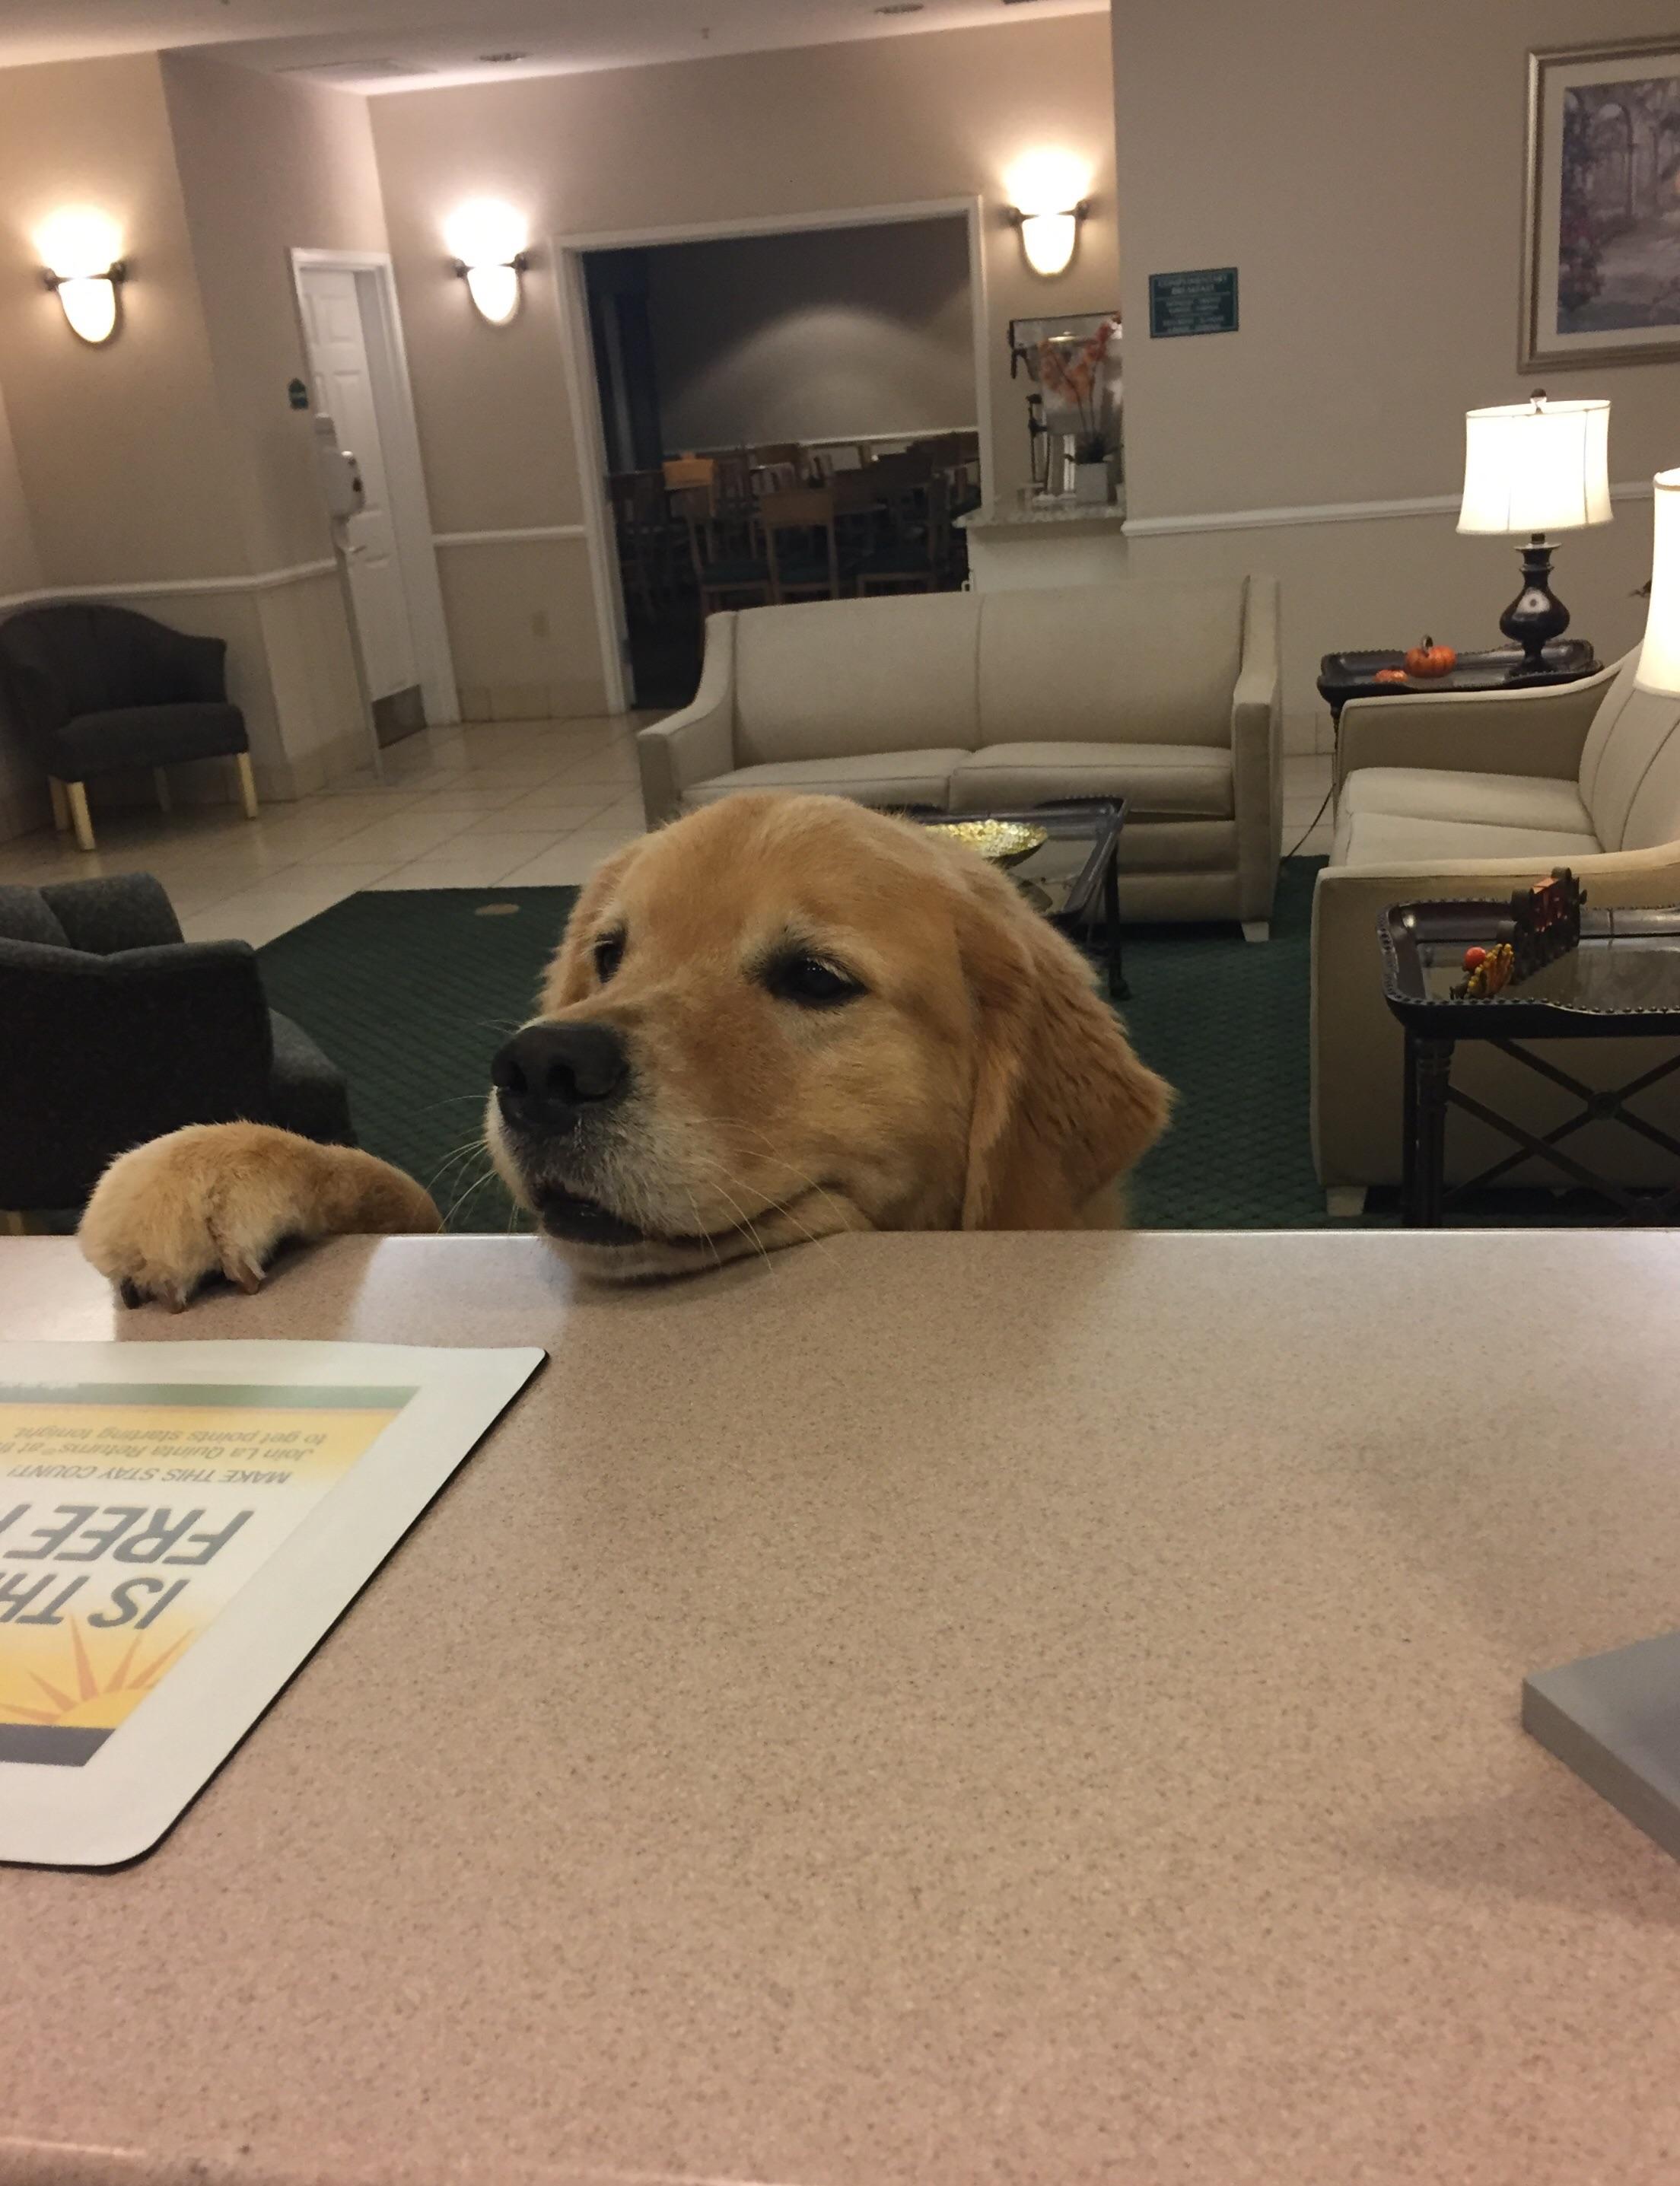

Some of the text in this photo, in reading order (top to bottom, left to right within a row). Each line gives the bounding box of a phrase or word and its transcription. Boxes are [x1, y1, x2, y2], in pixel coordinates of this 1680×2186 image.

[97, 1426, 183, 1442] starting
[186, 1430, 260, 1443] points
[259, 1430, 302, 1444] get
[304, 1433, 327, 1445] to
[17, 1443, 45, 1454] at
[151, 1446, 224, 1459] Quinta
[230, 1447, 259, 1460] La
[263, 1448, 314, 1461] Join
[6, 1465, 293, 1484] MAKE THIS STAY COUNT!
[3, 1505, 254, 1564] FREE
[0, 1573, 190, 1629] IS TH
